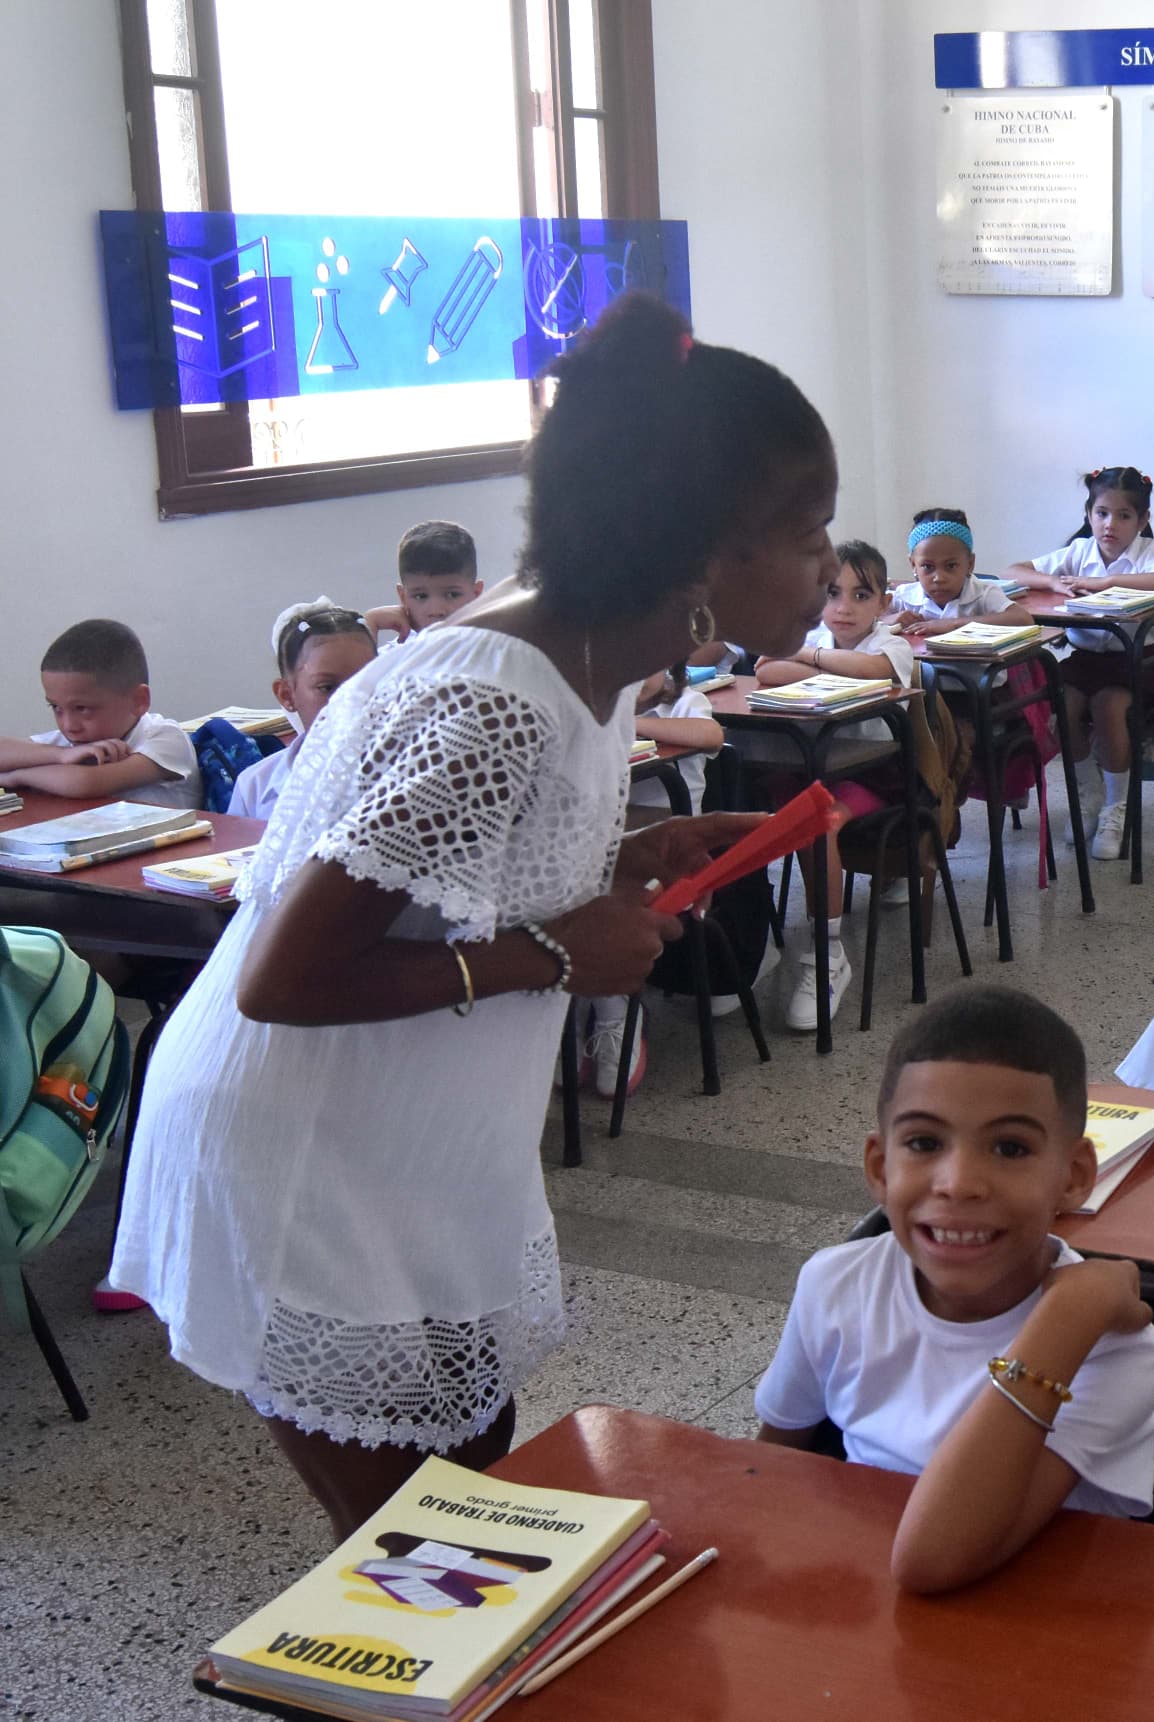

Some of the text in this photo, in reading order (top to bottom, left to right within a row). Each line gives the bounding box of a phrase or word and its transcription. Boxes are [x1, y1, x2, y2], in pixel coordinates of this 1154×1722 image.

[975, 110, 1077, 121] HIMNO NACIONAL
[1001, 123, 1049, 134] DE CUBA
[417, 1494, 585, 1535] CUADERNO DE TRABAJO
[466, 1495, 559, 1517] primer grado
[266, 1631, 434, 1682] ESCRITURA
